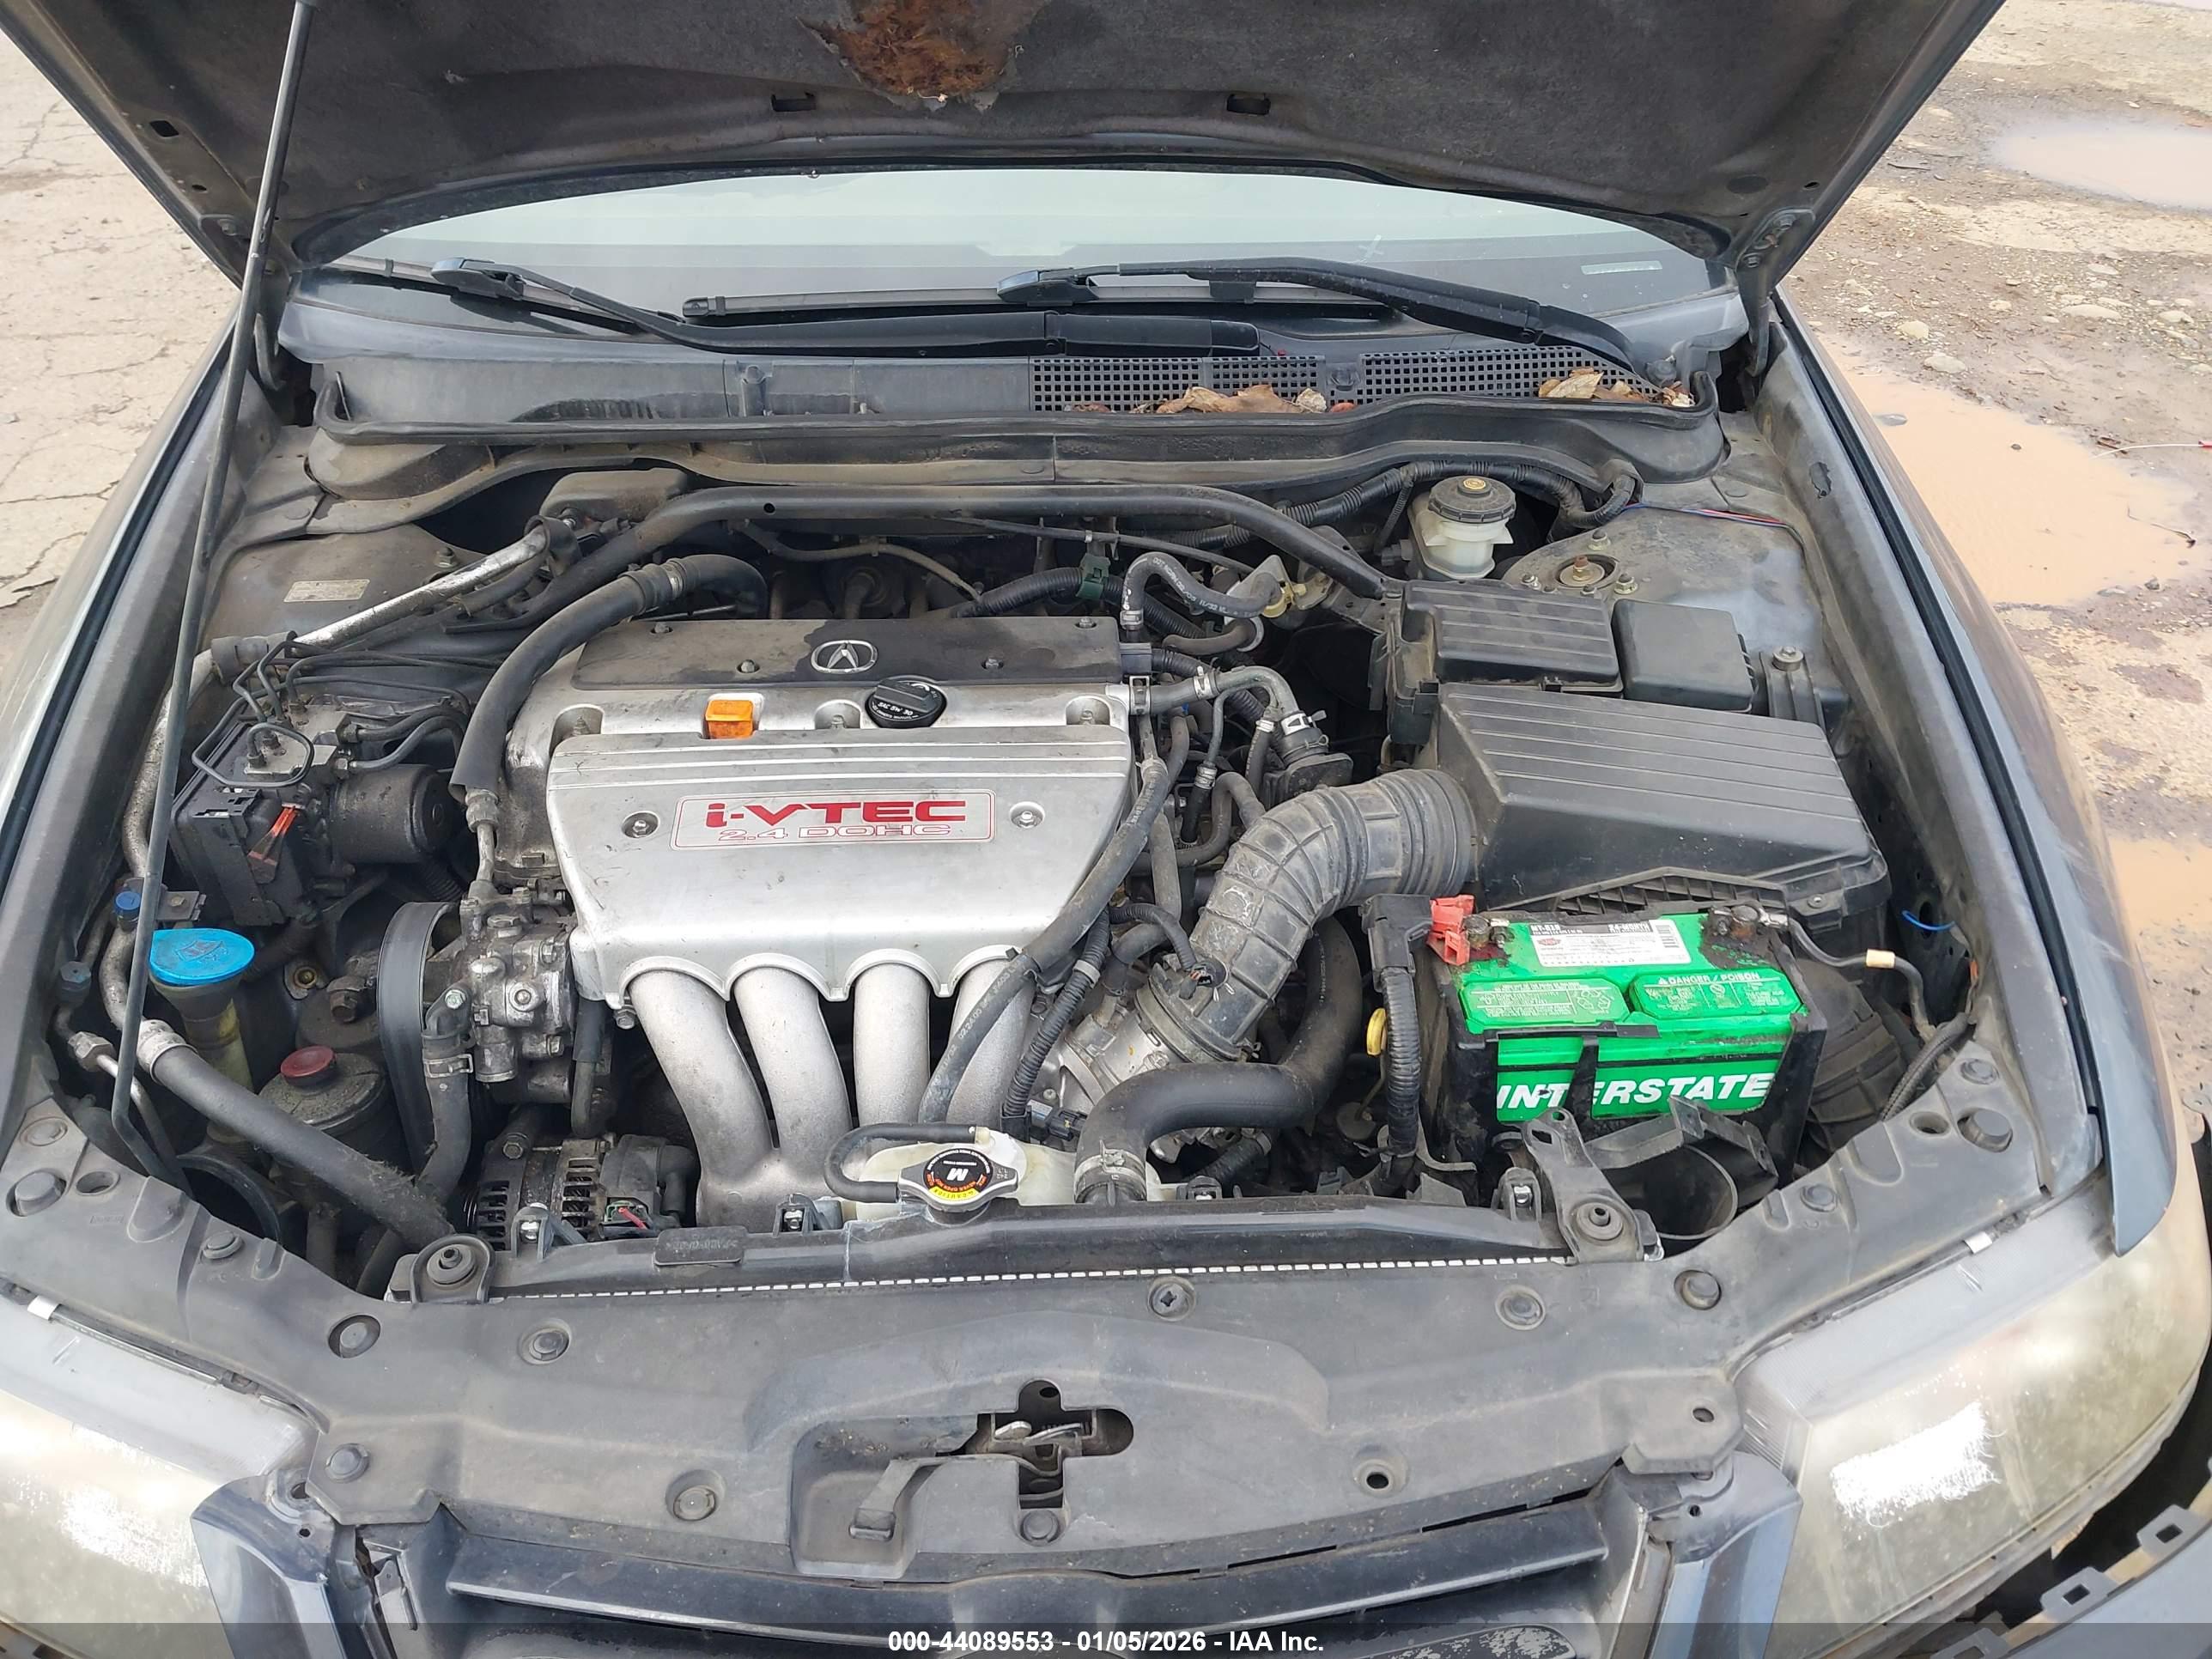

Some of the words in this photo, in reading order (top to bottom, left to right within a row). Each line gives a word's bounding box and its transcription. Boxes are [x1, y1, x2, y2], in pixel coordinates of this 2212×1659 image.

[706, 799, 966, 828] i-VTEC
[719, 827, 789, 842] 2.4
[799, 823, 951, 839] DOHC
[1668, 975, 1710, 985] DANGER
[1720, 972, 1759, 981] POISON
[933, 1188, 968, 1200] CAUTION
